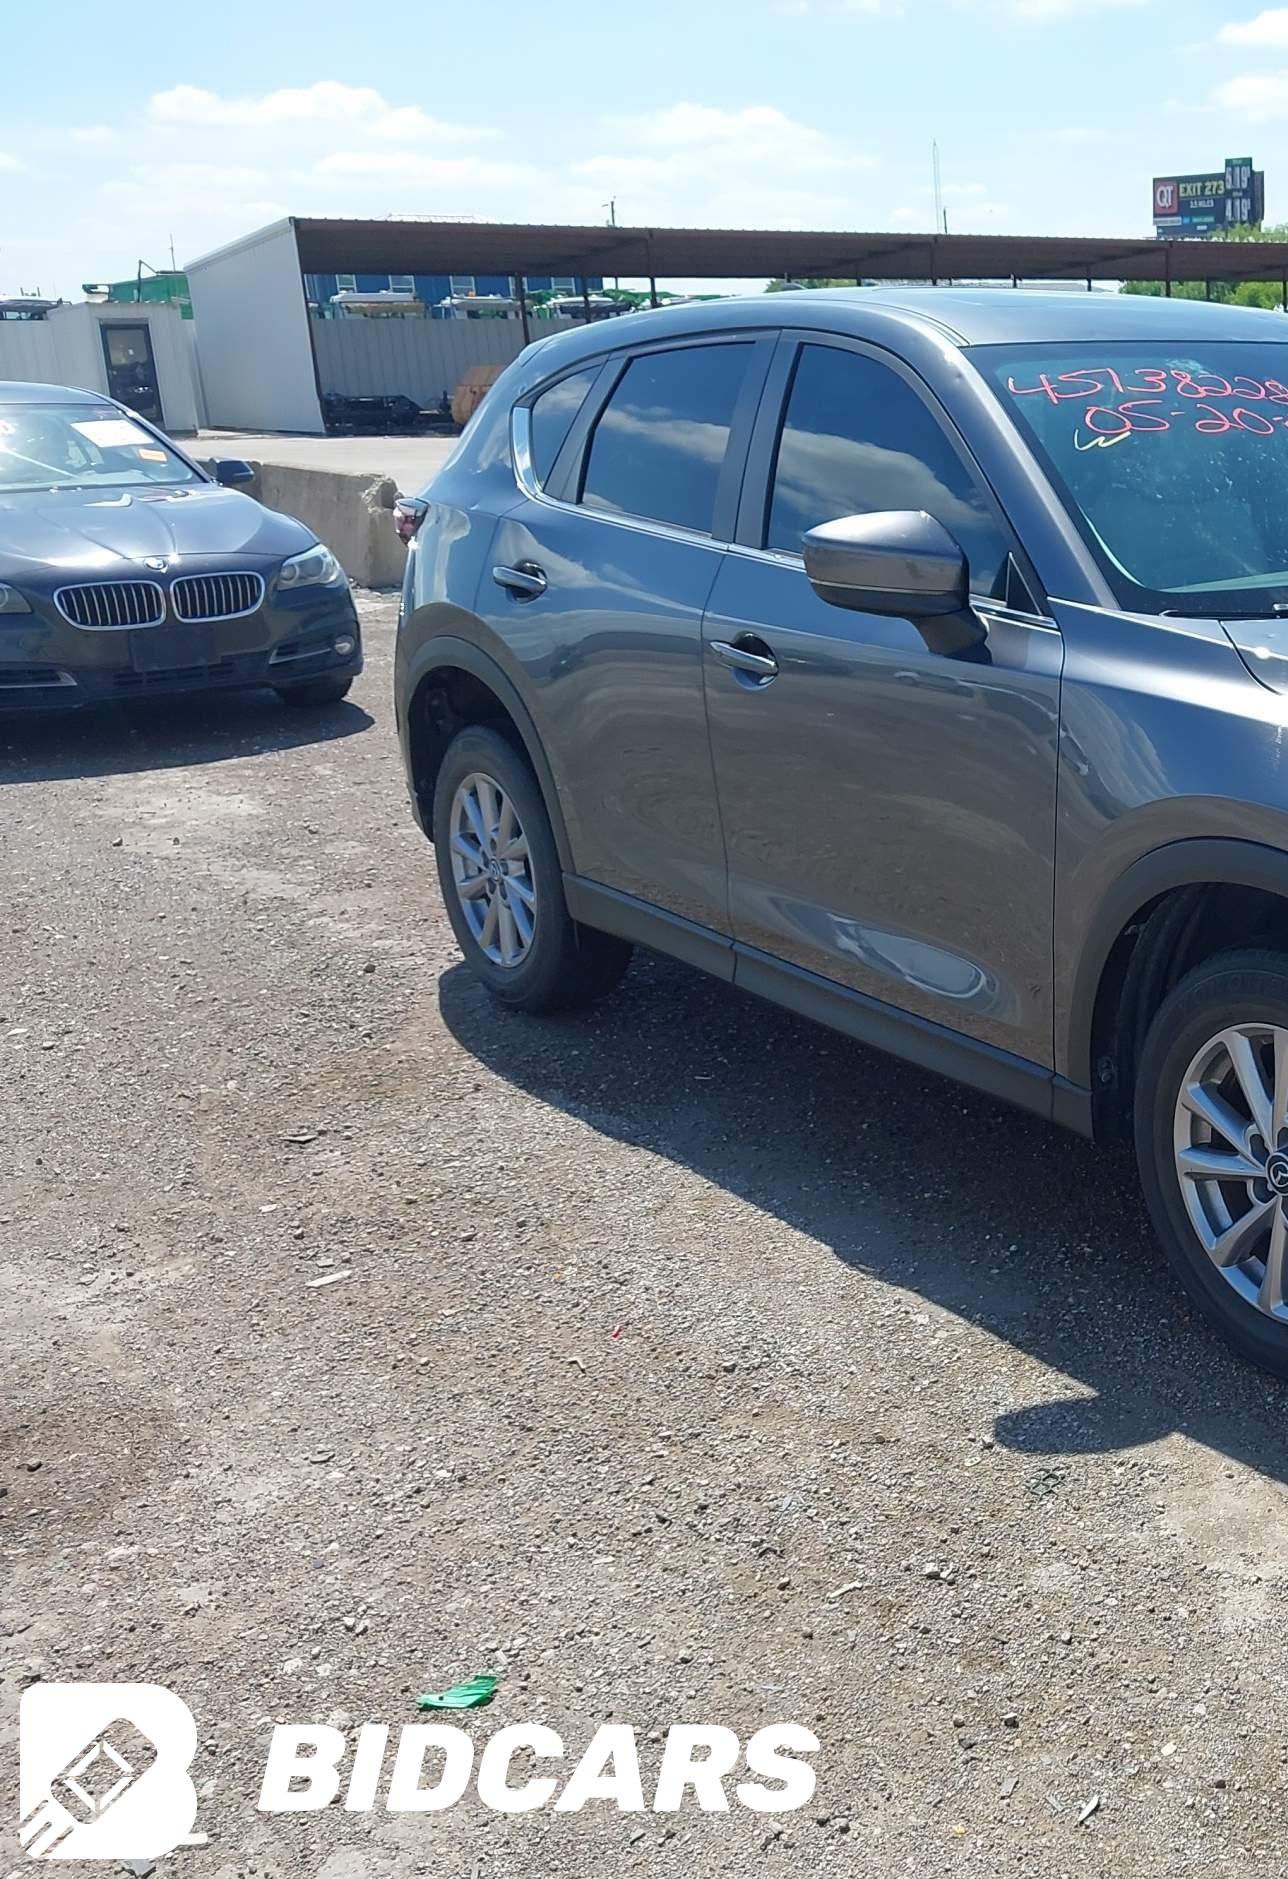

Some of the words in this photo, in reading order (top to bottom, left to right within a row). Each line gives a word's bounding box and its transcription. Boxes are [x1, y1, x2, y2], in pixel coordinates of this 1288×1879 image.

[1156, 185, 1174, 208] QT
[1179, 182, 1202, 197] EXIT
[1204, 180, 1225, 195] 273
